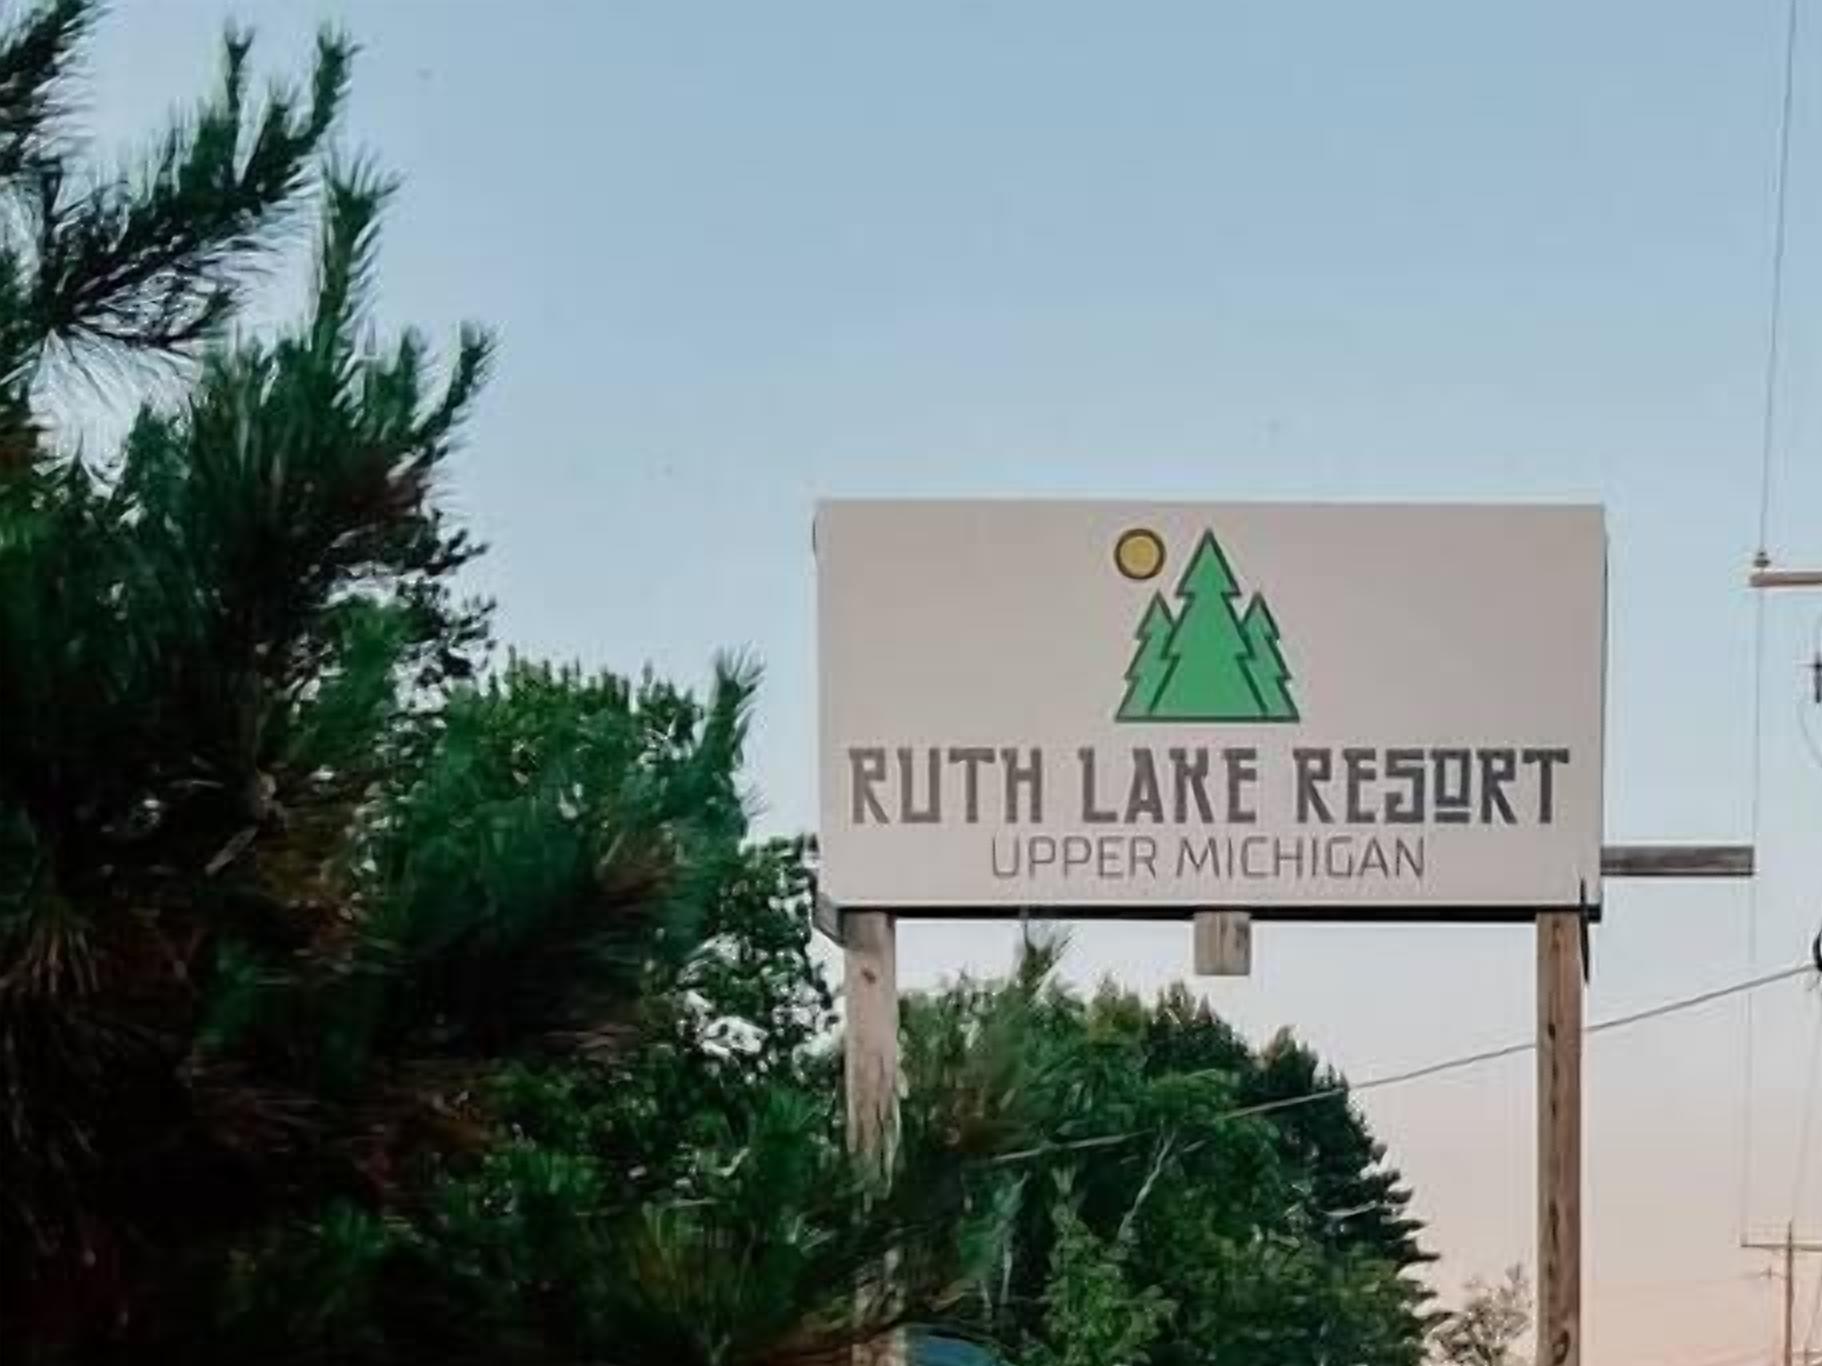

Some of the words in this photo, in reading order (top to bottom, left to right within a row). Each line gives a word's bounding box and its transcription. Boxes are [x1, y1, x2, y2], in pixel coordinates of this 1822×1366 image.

[848, 747, 1042, 824] RUTH
[1078, 747, 1257, 824] LAKE
[1293, 747, 1570, 824] RESORT
[991, 835, 1158, 879] UPPER
[1176, 836, 1426, 879] MICHIGAN
